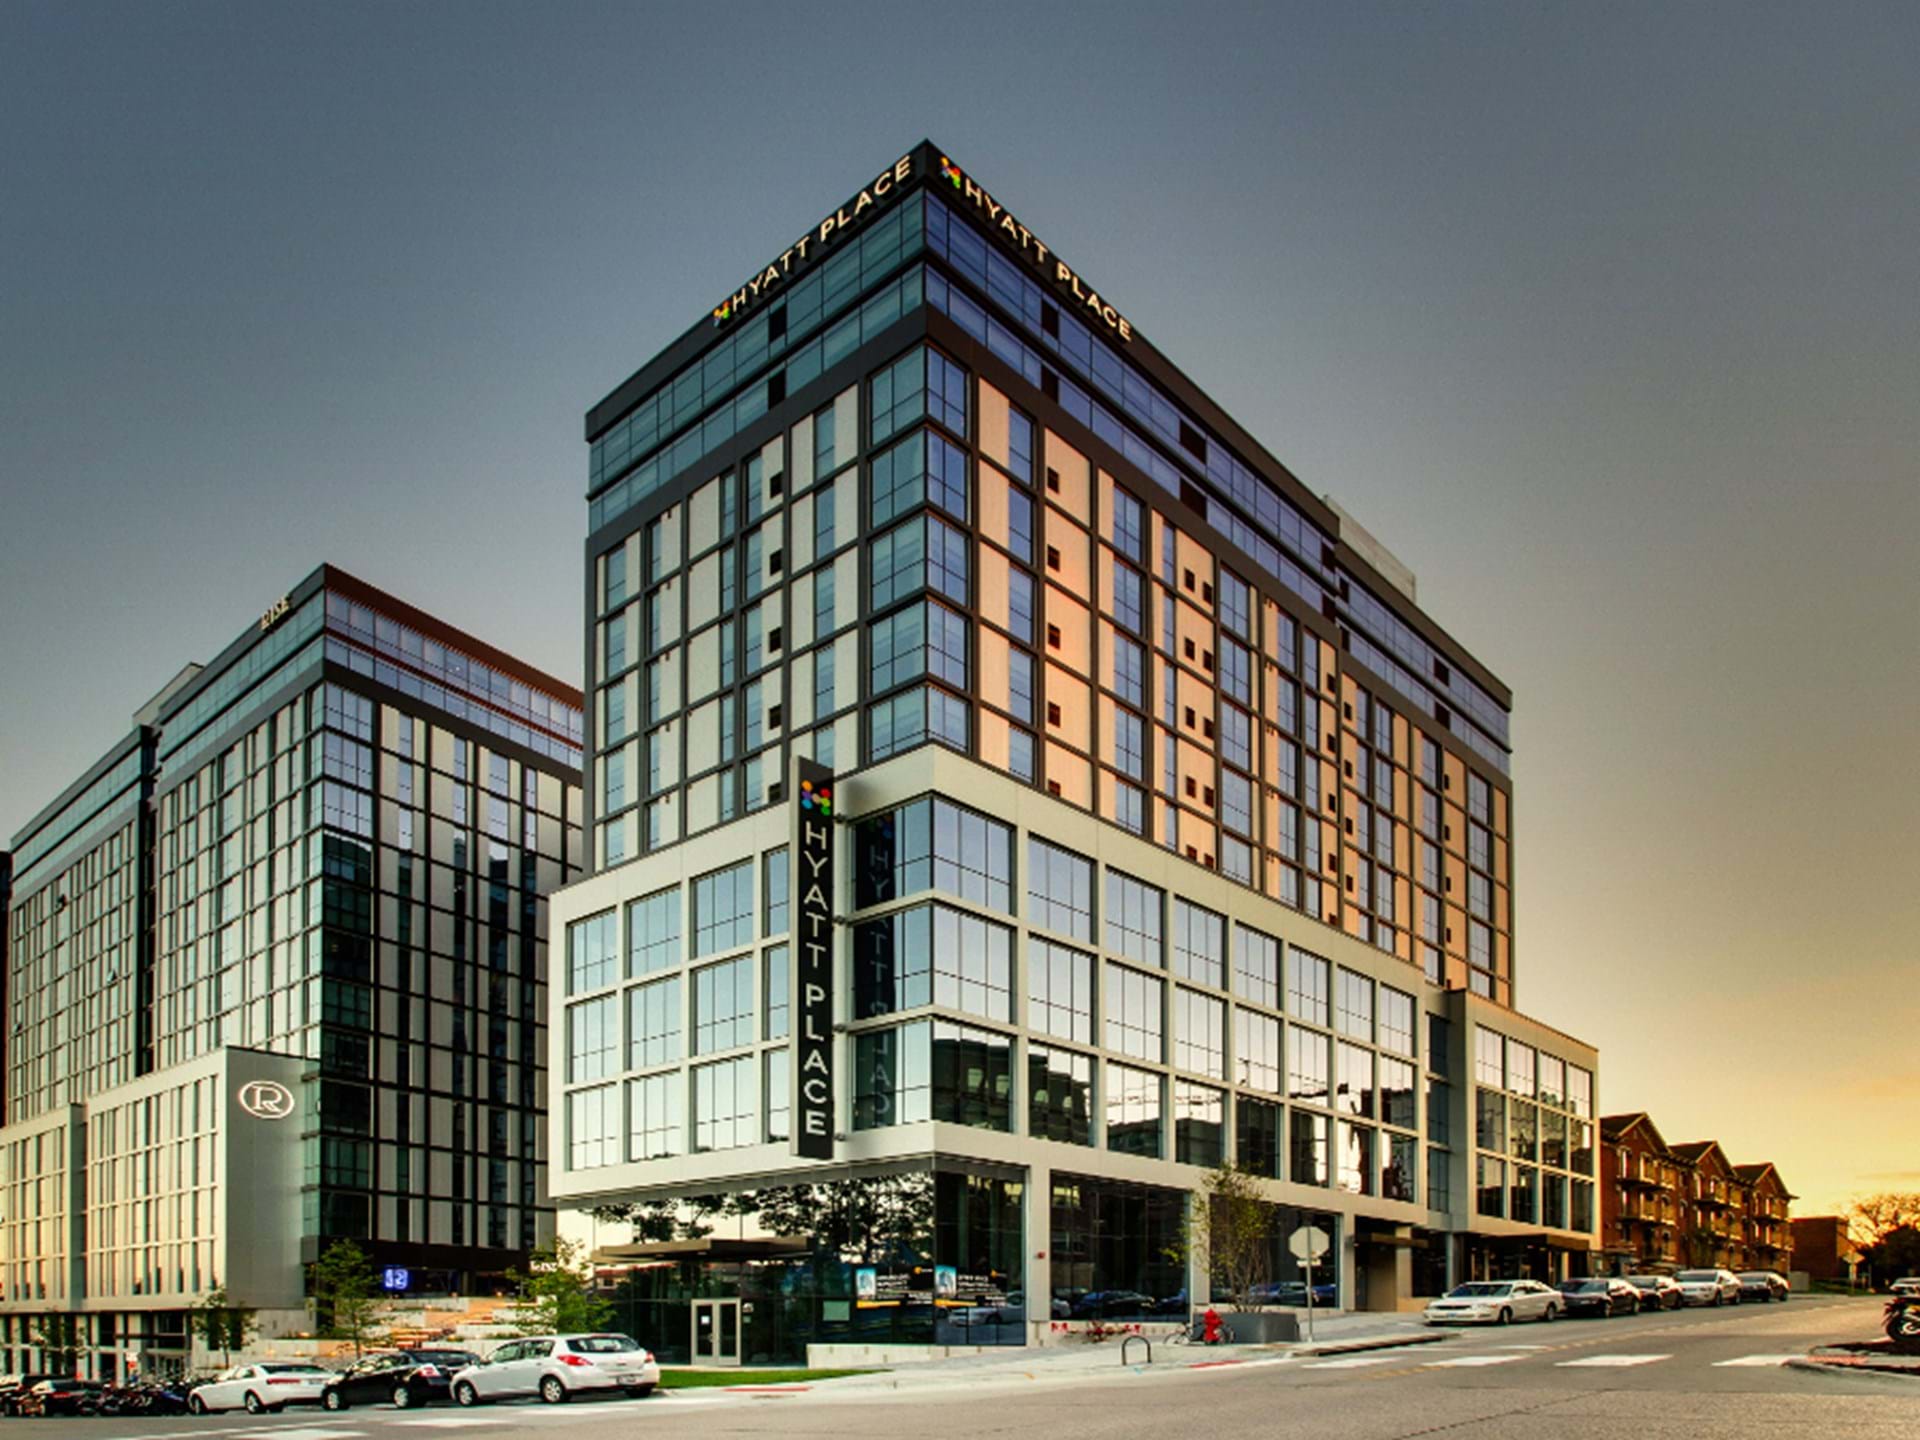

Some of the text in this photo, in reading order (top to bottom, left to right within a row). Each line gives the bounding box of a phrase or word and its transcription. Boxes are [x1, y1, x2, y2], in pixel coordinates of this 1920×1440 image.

[732, 155, 911, 313] HYATT PLACE
[964, 177, 1132, 342] HYATT PLACE
[803, 820, 829, 1136] HYATT PLACE
